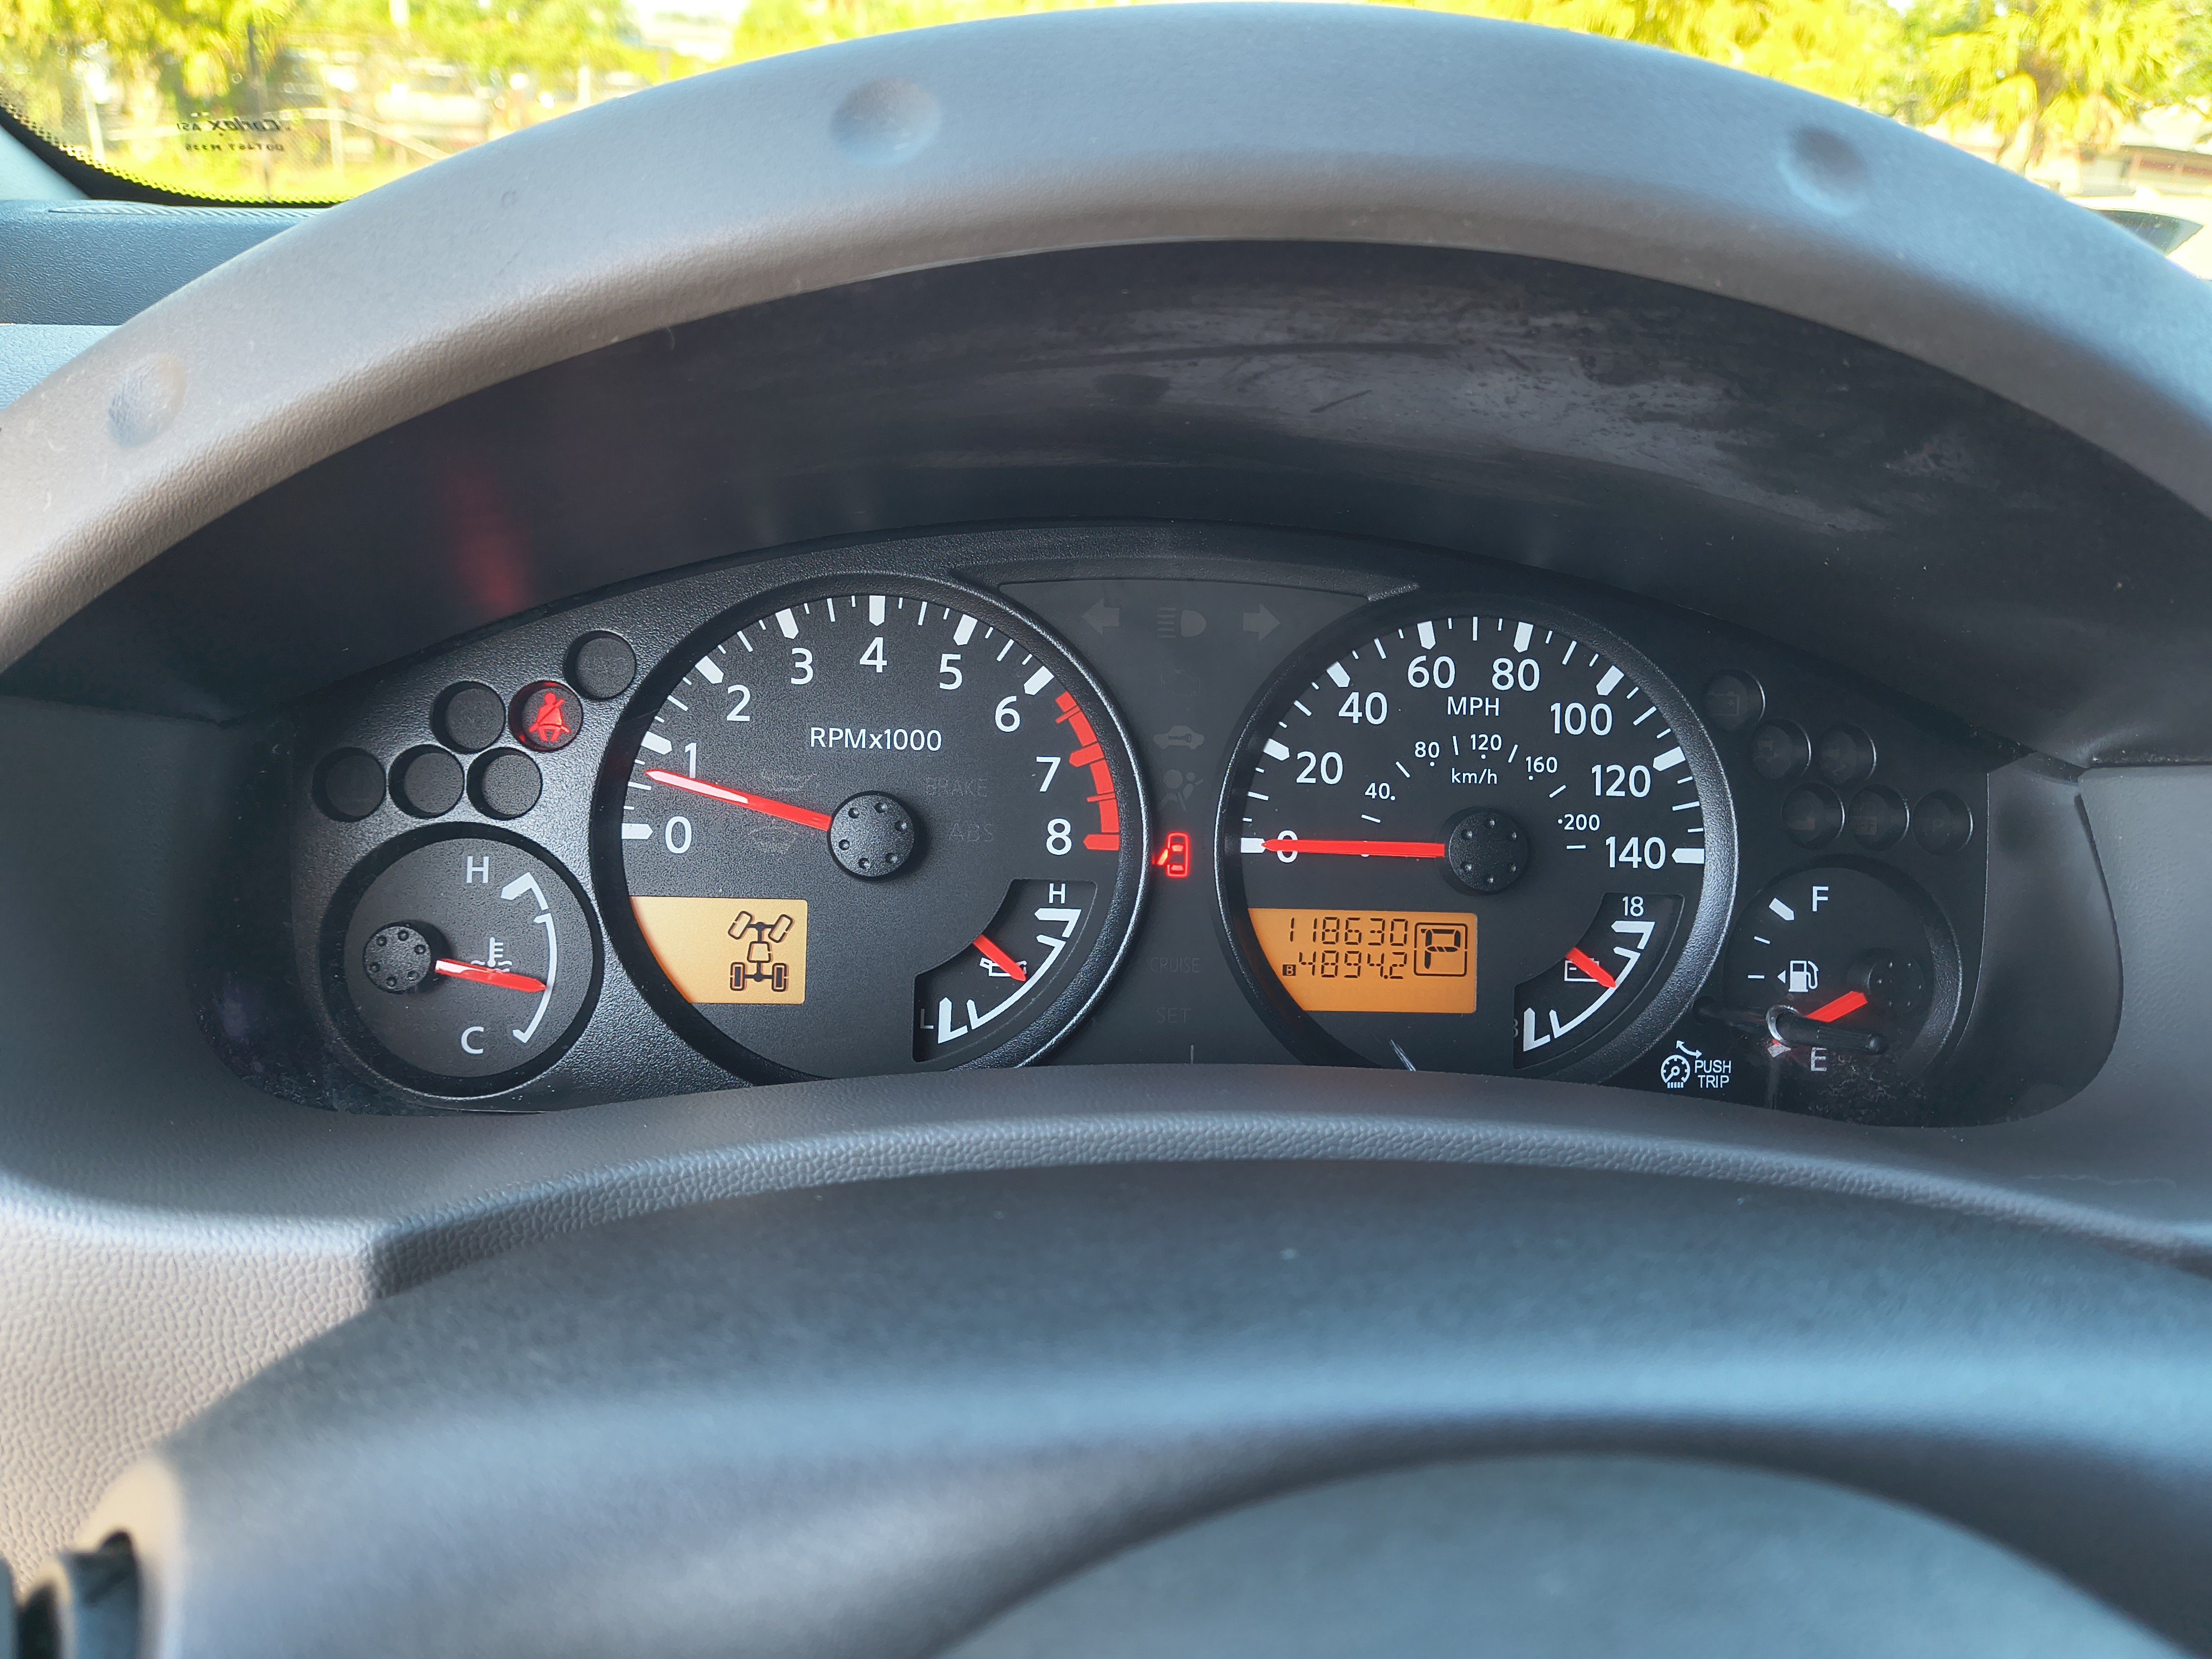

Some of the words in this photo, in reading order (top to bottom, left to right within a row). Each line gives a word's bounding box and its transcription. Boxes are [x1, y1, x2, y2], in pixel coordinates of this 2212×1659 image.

[791, 648, 813, 685] 3
[860, 637, 887, 673] 4
[940, 653, 962, 690] 5
[1408, 656, 1455, 689] 60
[1492, 658, 1540, 691] 80
[726, 684, 751, 721] 2
[995, 696, 1021, 732] 6
[1339, 692, 1387, 725] 40
[1447, 696, 1499, 717] MPH
[1551, 703, 1613, 736] 100
[811, 727, 942, 751] RPMx1000
[1415, 741, 1440, 758] 80
[1471, 734, 1502, 751] 120
[684, 742, 697, 778] 1
[1036, 757, 1061, 792] 7
[1297, 751, 1343, 784] 20
[1526, 756, 1558, 773] 160
[1452, 767, 1498, 784] km/h
[1592, 765, 1651, 798] 120
[1365, 783, 1390, 799] 40
[665, 816, 692, 854] 0
[1564, 813, 1600, 831] 200
[1047, 819, 1072, 855] 8
[1277, 831, 1298, 863] 0
[1606, 836, 1666, 869] 140
[467, 856, 490, 884] H
[1049, 884, 1066, 904] H
[1622, 896, 1644, 917] 18
[1812, 886, 1829, 912] F
[1290, 916, 1408, 946] 118630
[1421, 928, 1461, 969] P
[1283, 965, 1296, 976] B
[1299, 950, 1407, 979] 4894.2
[920, 1008, 934, 1029] L
[1156, 1007, 1192, 1024] SET
[461, 1026, 484, 1054] C
[1695, 1060, 1731, 1074] PUSH
[1811, 1047, 1827, 1072] E
[1697, 1075, 1730, 1088] TRIP
